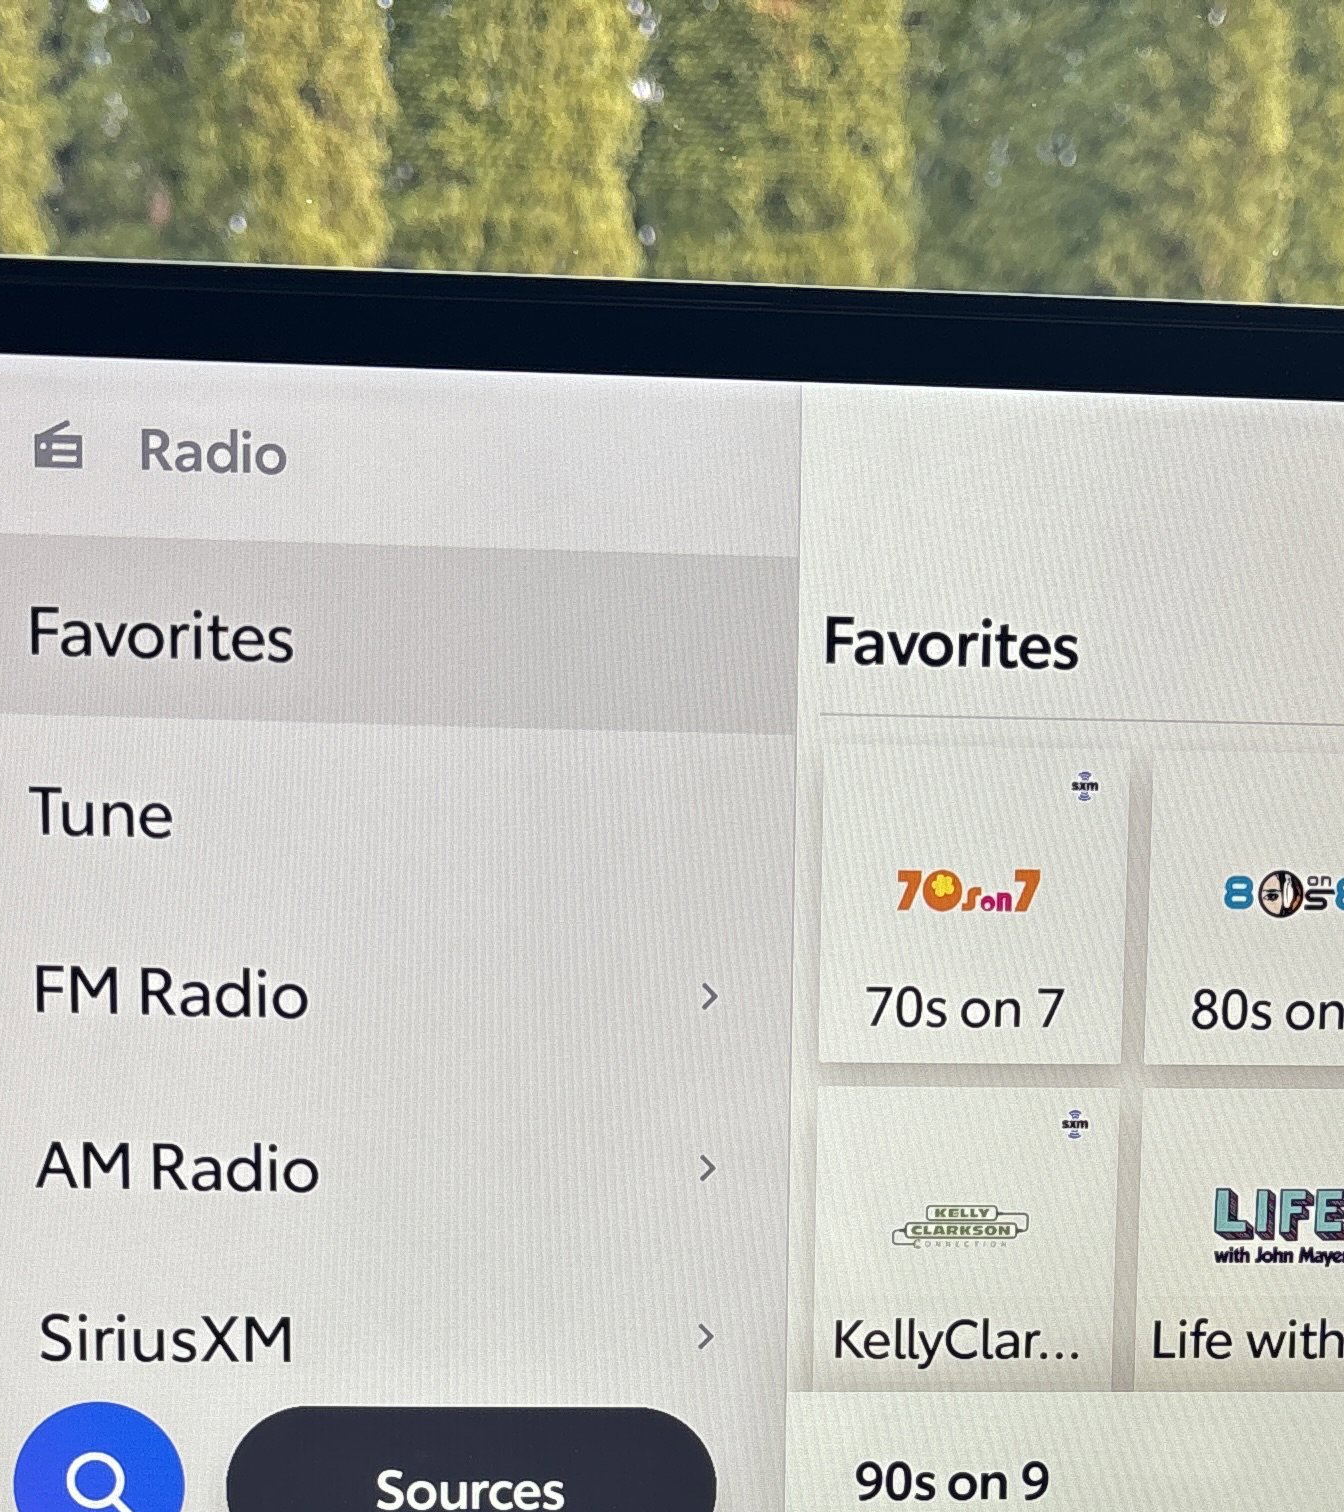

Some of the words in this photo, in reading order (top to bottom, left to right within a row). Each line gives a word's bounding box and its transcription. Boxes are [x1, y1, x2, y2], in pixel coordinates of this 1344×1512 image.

[142, 429, 286, 475] Radio
[31, 607, 293, 663] Favorites
[826, 616, 1078, 670] Favorites
[1071, 780, 1099, 793] sxm
[29, 786, 172, 839] Tune
[37, 965, 117, 1014] FM
[141, 968, 307, 1019] Radio
[867, 986, 947, 1028] 70s
[961, 998, 1020, 1028] on
[1038, 989, 1064, 1027] 7
[1192, 989, 1271, 1030] 80s
[1286, 1001, 1344, 1030] on
[1061, 1118, 1089, 1131] sxm
[36, 1142, 129, 1189] AM
[153, 1143, 318, 1193] Radio
[911, 1225, 1011, 1236] CLARKSON
[934, 1207, 990, 1218] KELLY
[1214, 1246, 1250, 1263] with
[1254, 1246, 1293, 1263] John
[41, 1314, 290, 1362] SiriusXM
[835, 1318, 1078, 1369] KellyClar...
[1154, 1318, 1232, 1359] Life
[1247, 1318, 1344, 1359] with
[377, 1470, 564, 1510] Sources
[856, 1461, 935, 1501] 90s
[948, 1472, 1007, 1500] on
[1022, 1461, 1048, 1500] 9
